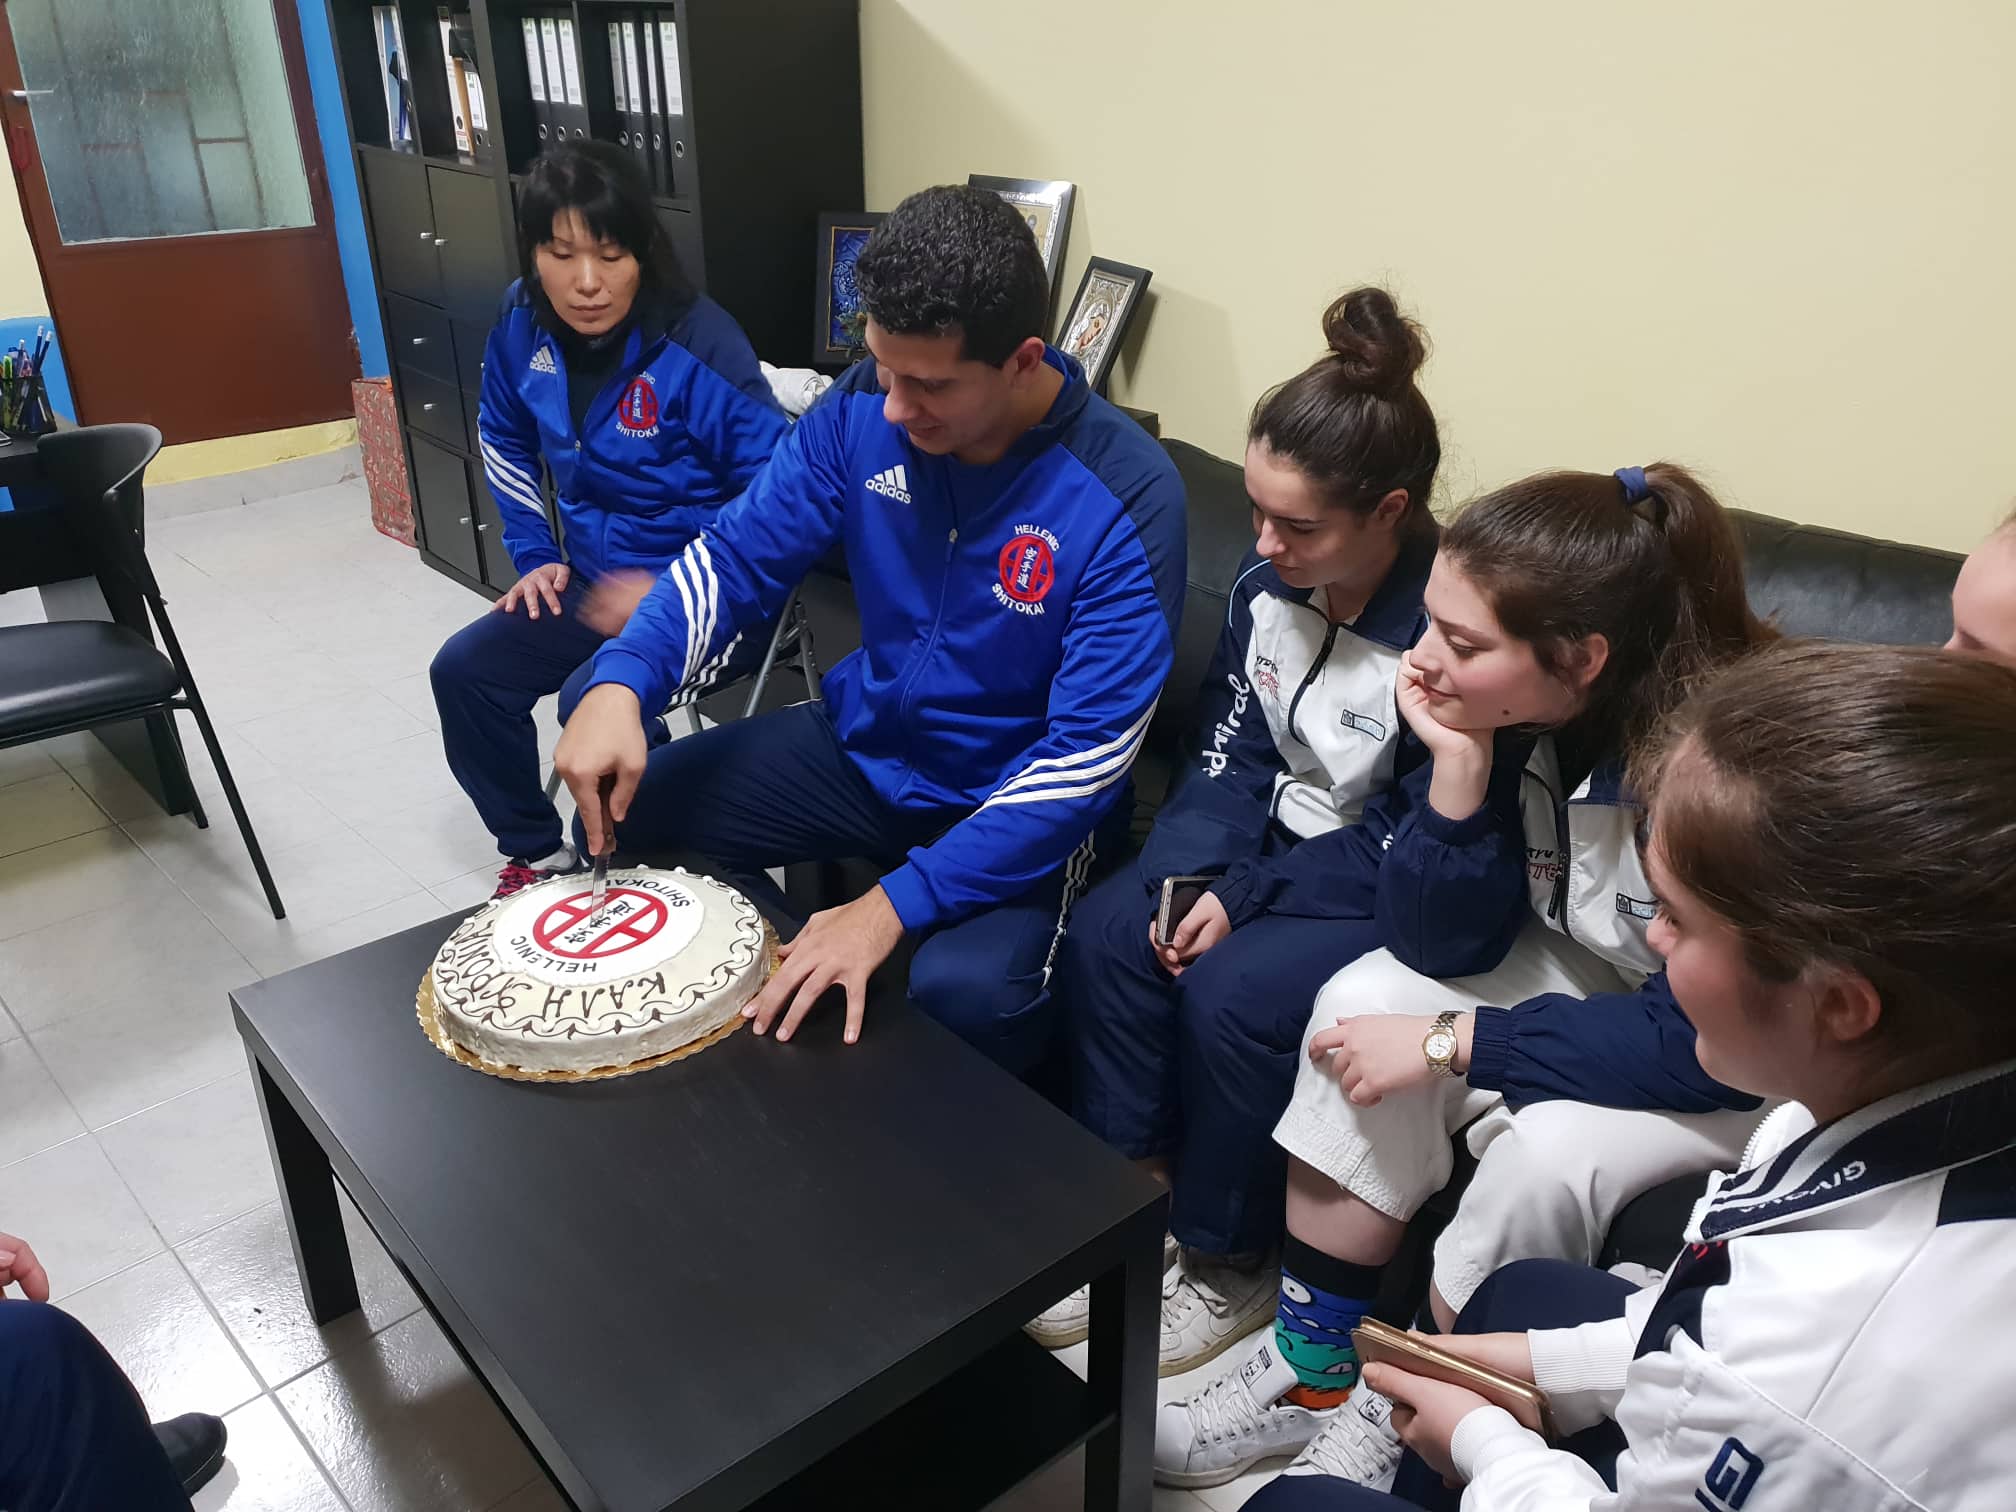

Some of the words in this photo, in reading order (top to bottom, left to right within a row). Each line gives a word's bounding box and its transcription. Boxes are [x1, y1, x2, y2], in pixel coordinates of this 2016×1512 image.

[529, 361, 557, 374] adidas
[865, 477, 912, 504] adidas
[1014, 524, 1060, 552] HELLENIC
[992, 582, 1045, 616] SHITOKAI
[510, 935, 597, 973] HELLENIC
